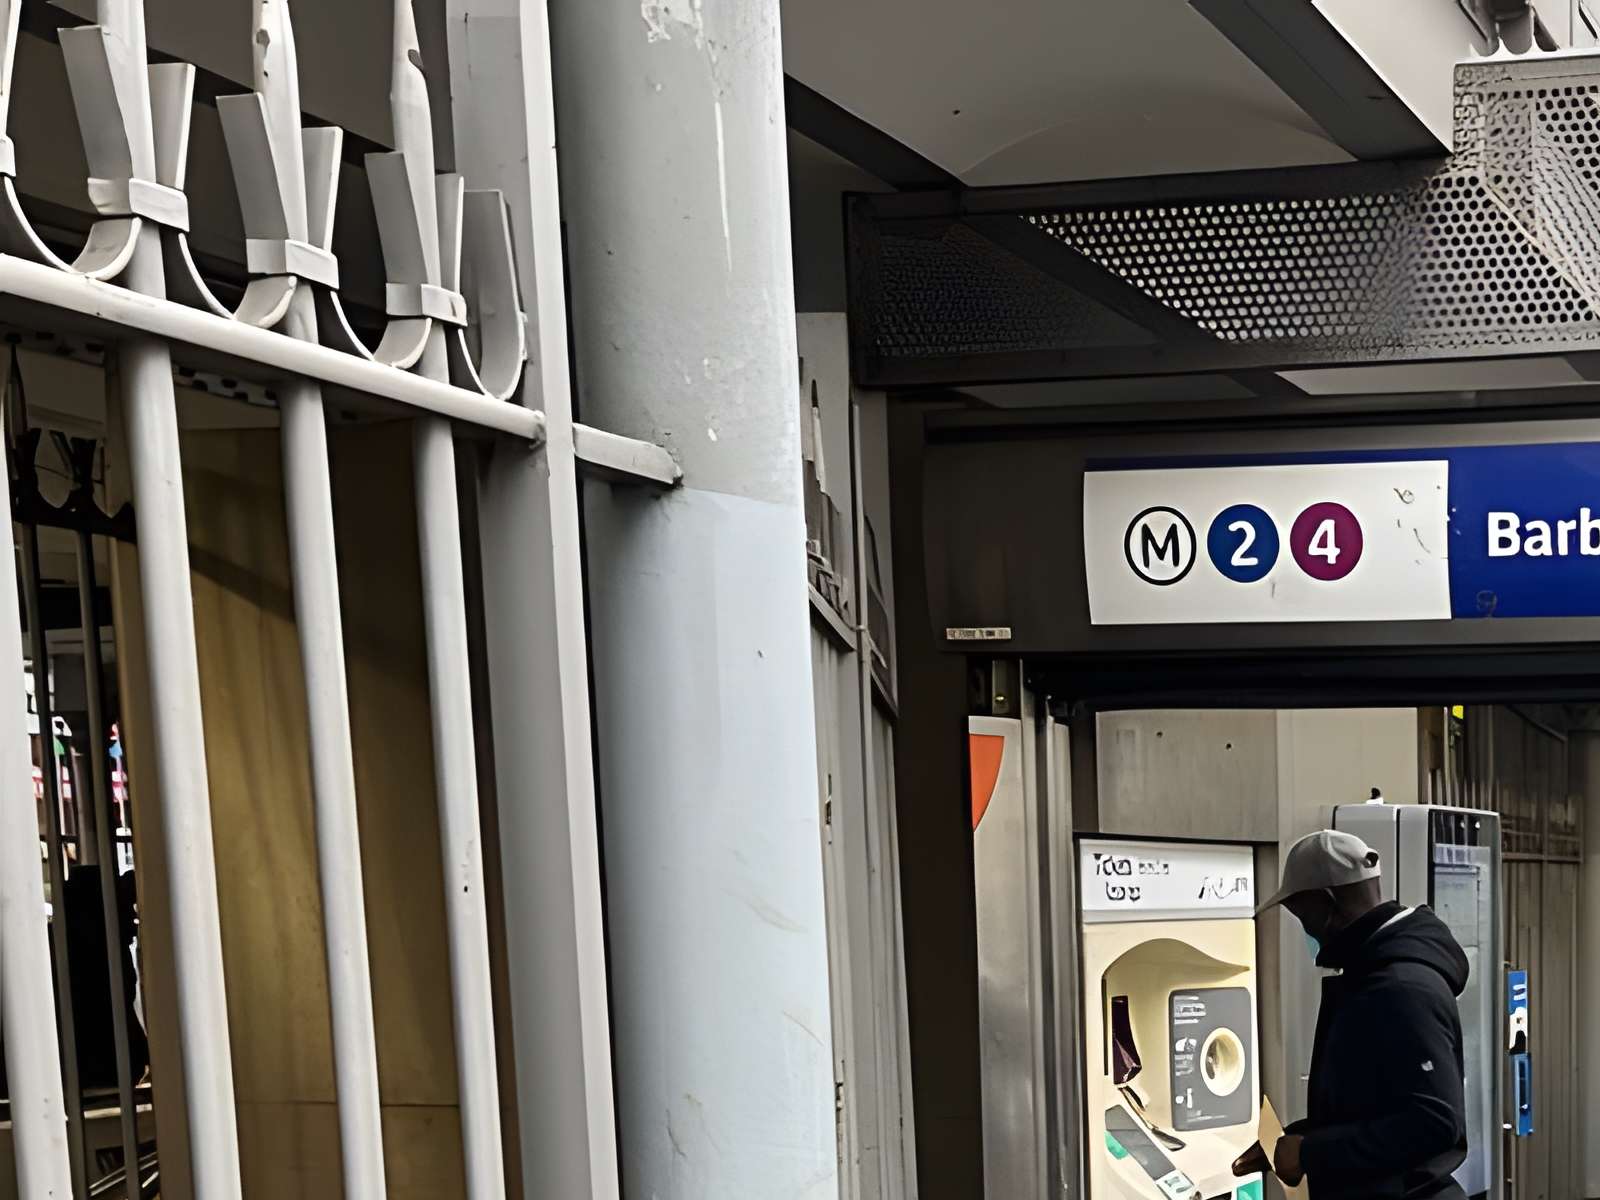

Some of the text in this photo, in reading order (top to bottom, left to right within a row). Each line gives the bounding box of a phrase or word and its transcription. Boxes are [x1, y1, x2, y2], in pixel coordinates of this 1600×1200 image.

[1141, 518, 1341, 569] M 2 4
